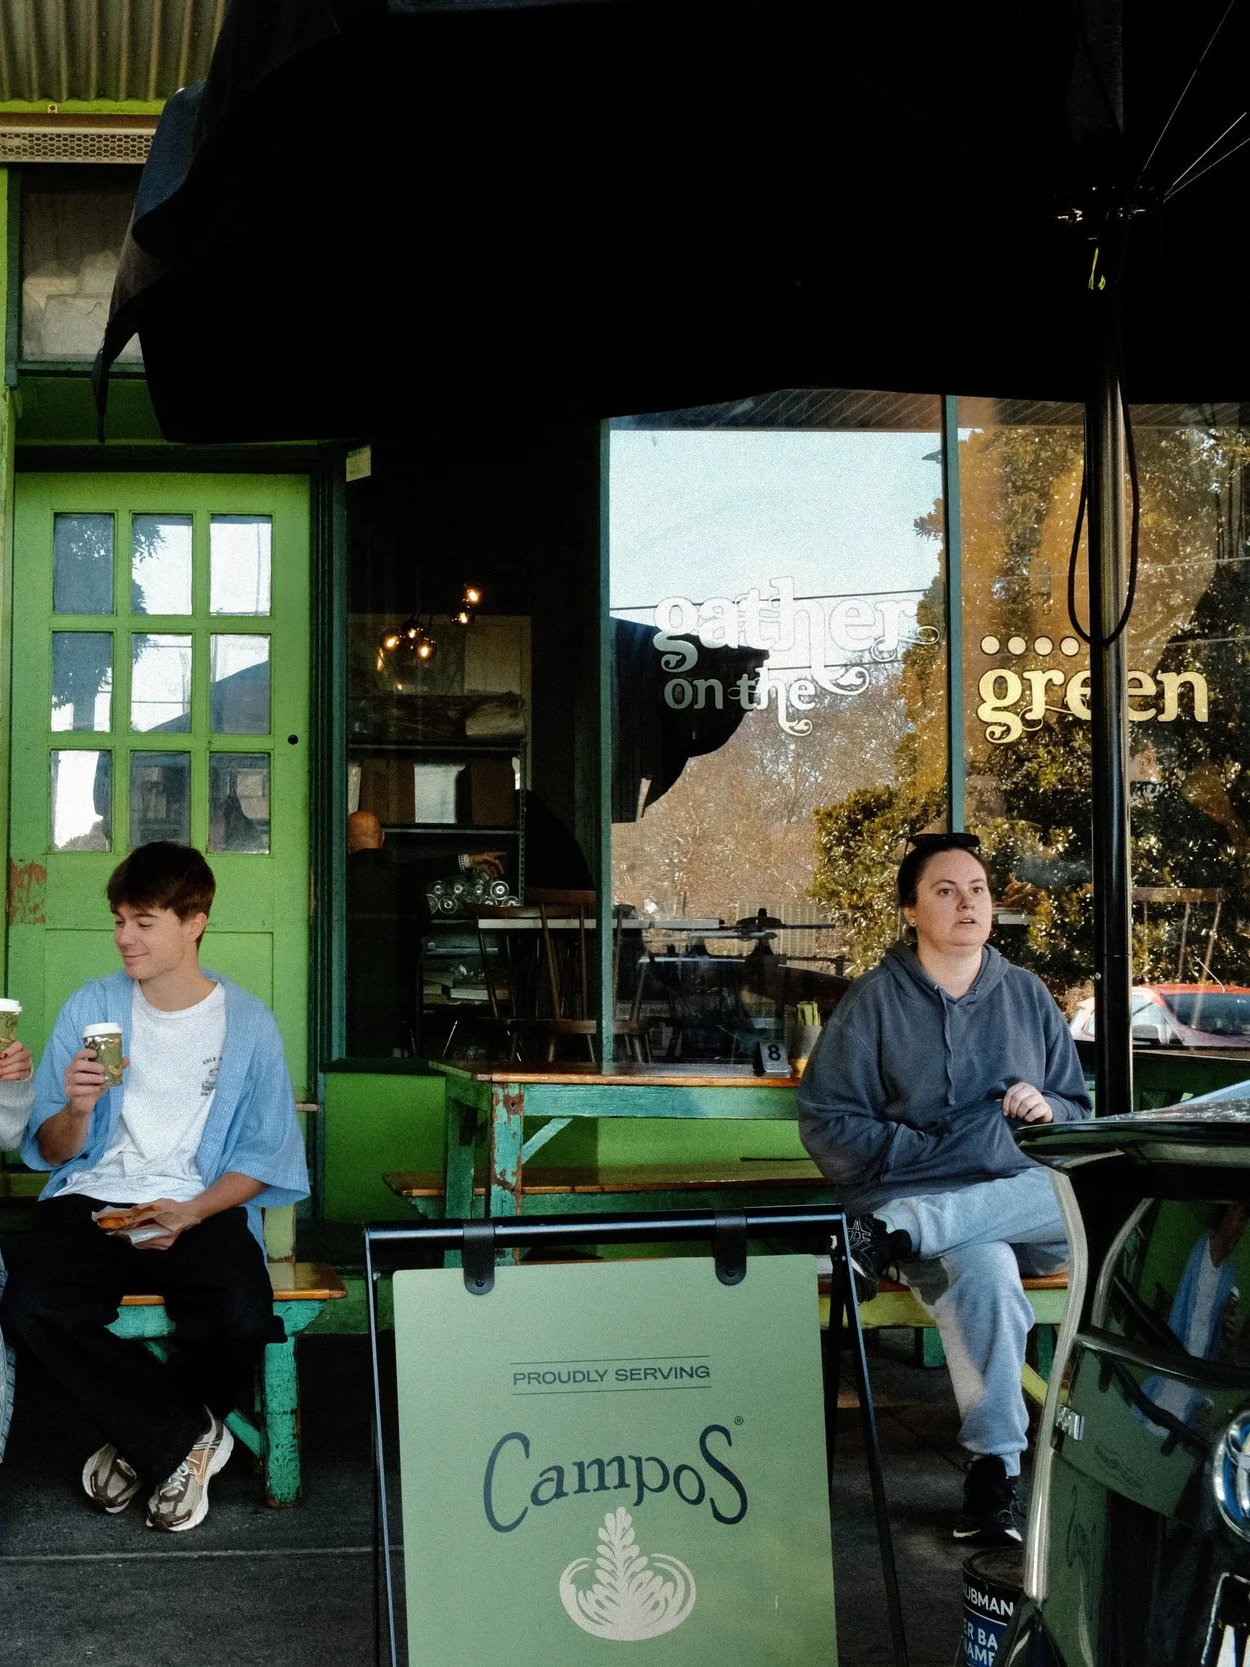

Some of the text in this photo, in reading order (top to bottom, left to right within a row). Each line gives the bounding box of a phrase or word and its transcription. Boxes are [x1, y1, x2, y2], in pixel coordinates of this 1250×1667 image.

[652, 576, 941, 696] gather
[663, 666, 817, 737] on the
[976, 667, 1209, 745] green
[768, 1044, 781, 1061] 8
[512, 1365, 711, 1386] PROUDLY SERVING
